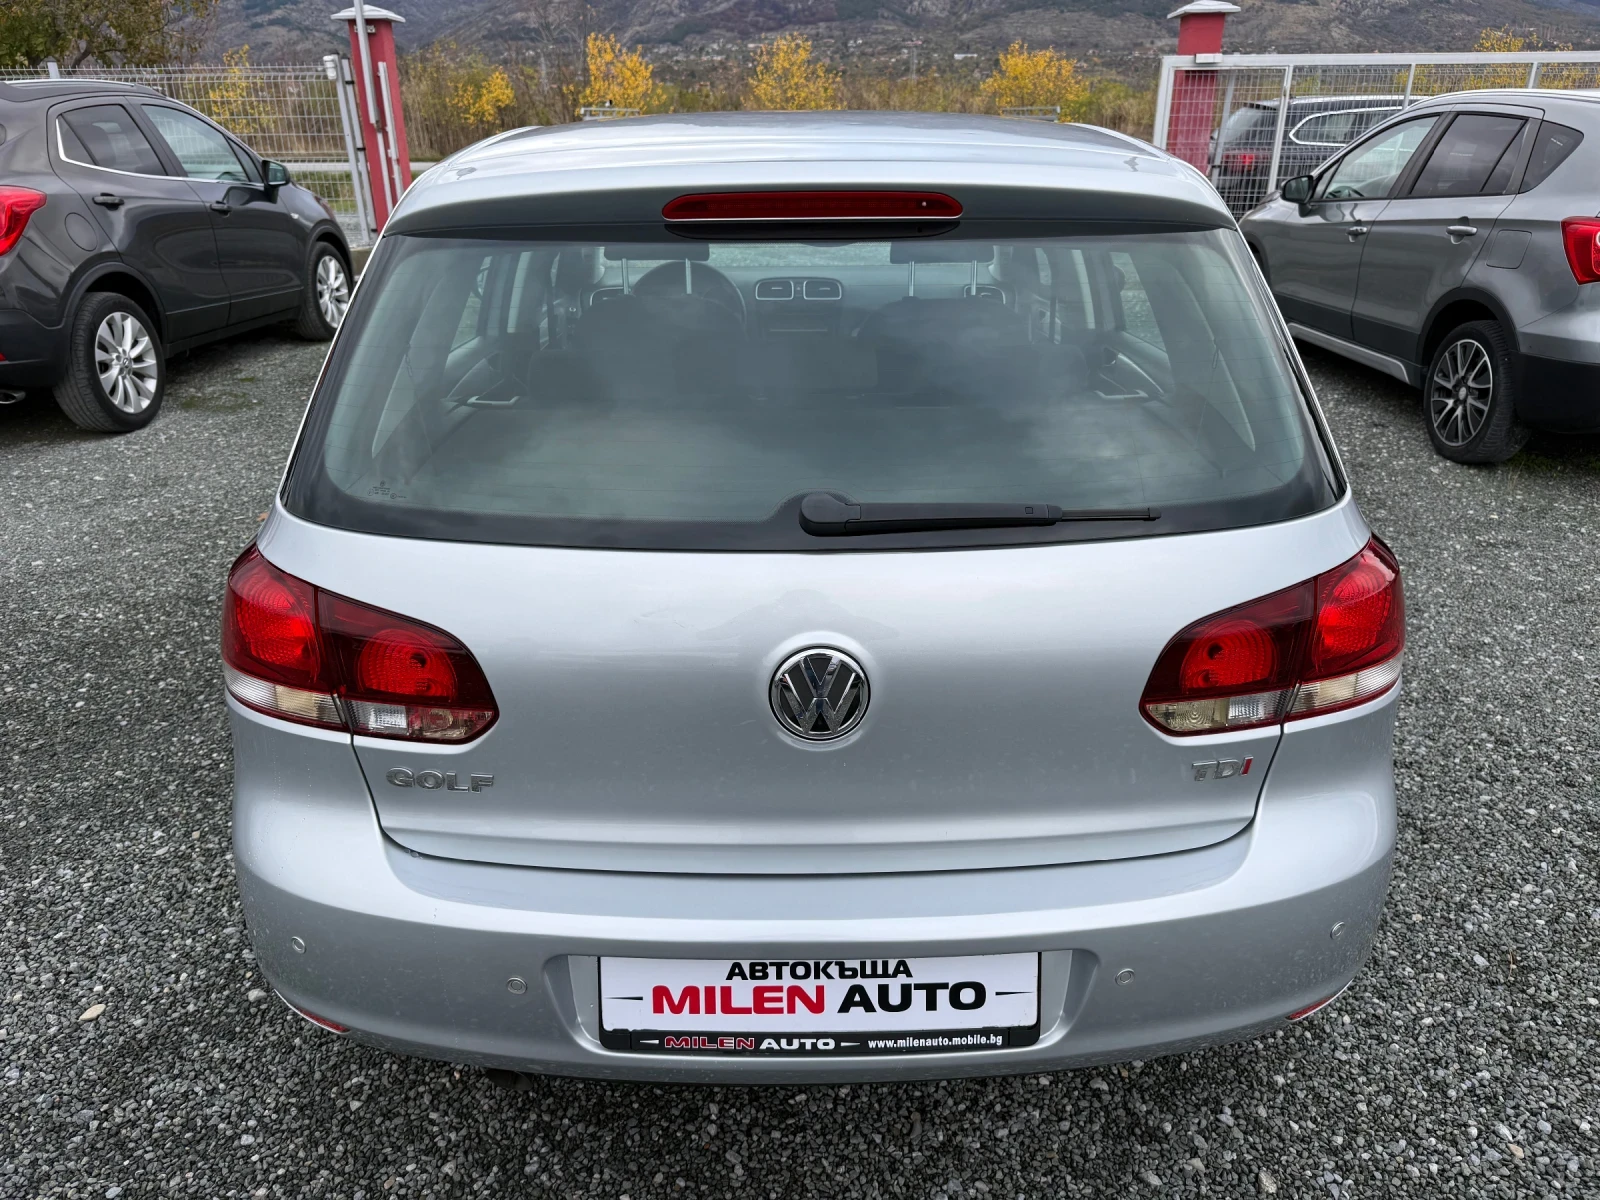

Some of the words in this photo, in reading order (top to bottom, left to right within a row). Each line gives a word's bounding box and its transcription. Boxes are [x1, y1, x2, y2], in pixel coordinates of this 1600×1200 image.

[386, 767, 494, 793] GOLF
[1191, 755, 1254, 782] TDI
[725, 959, 913, 981] АВТОКЪЩА
[652, 985, 825, 1015] MILEN
[837, 981, 987, 1014] AUTO
[664, 1036, 755, 1051] MILEN
[759, 1037, 836, 1050] AUTO
[868, 1034, 1003, 1050] www.milenauto.mobile.bg
